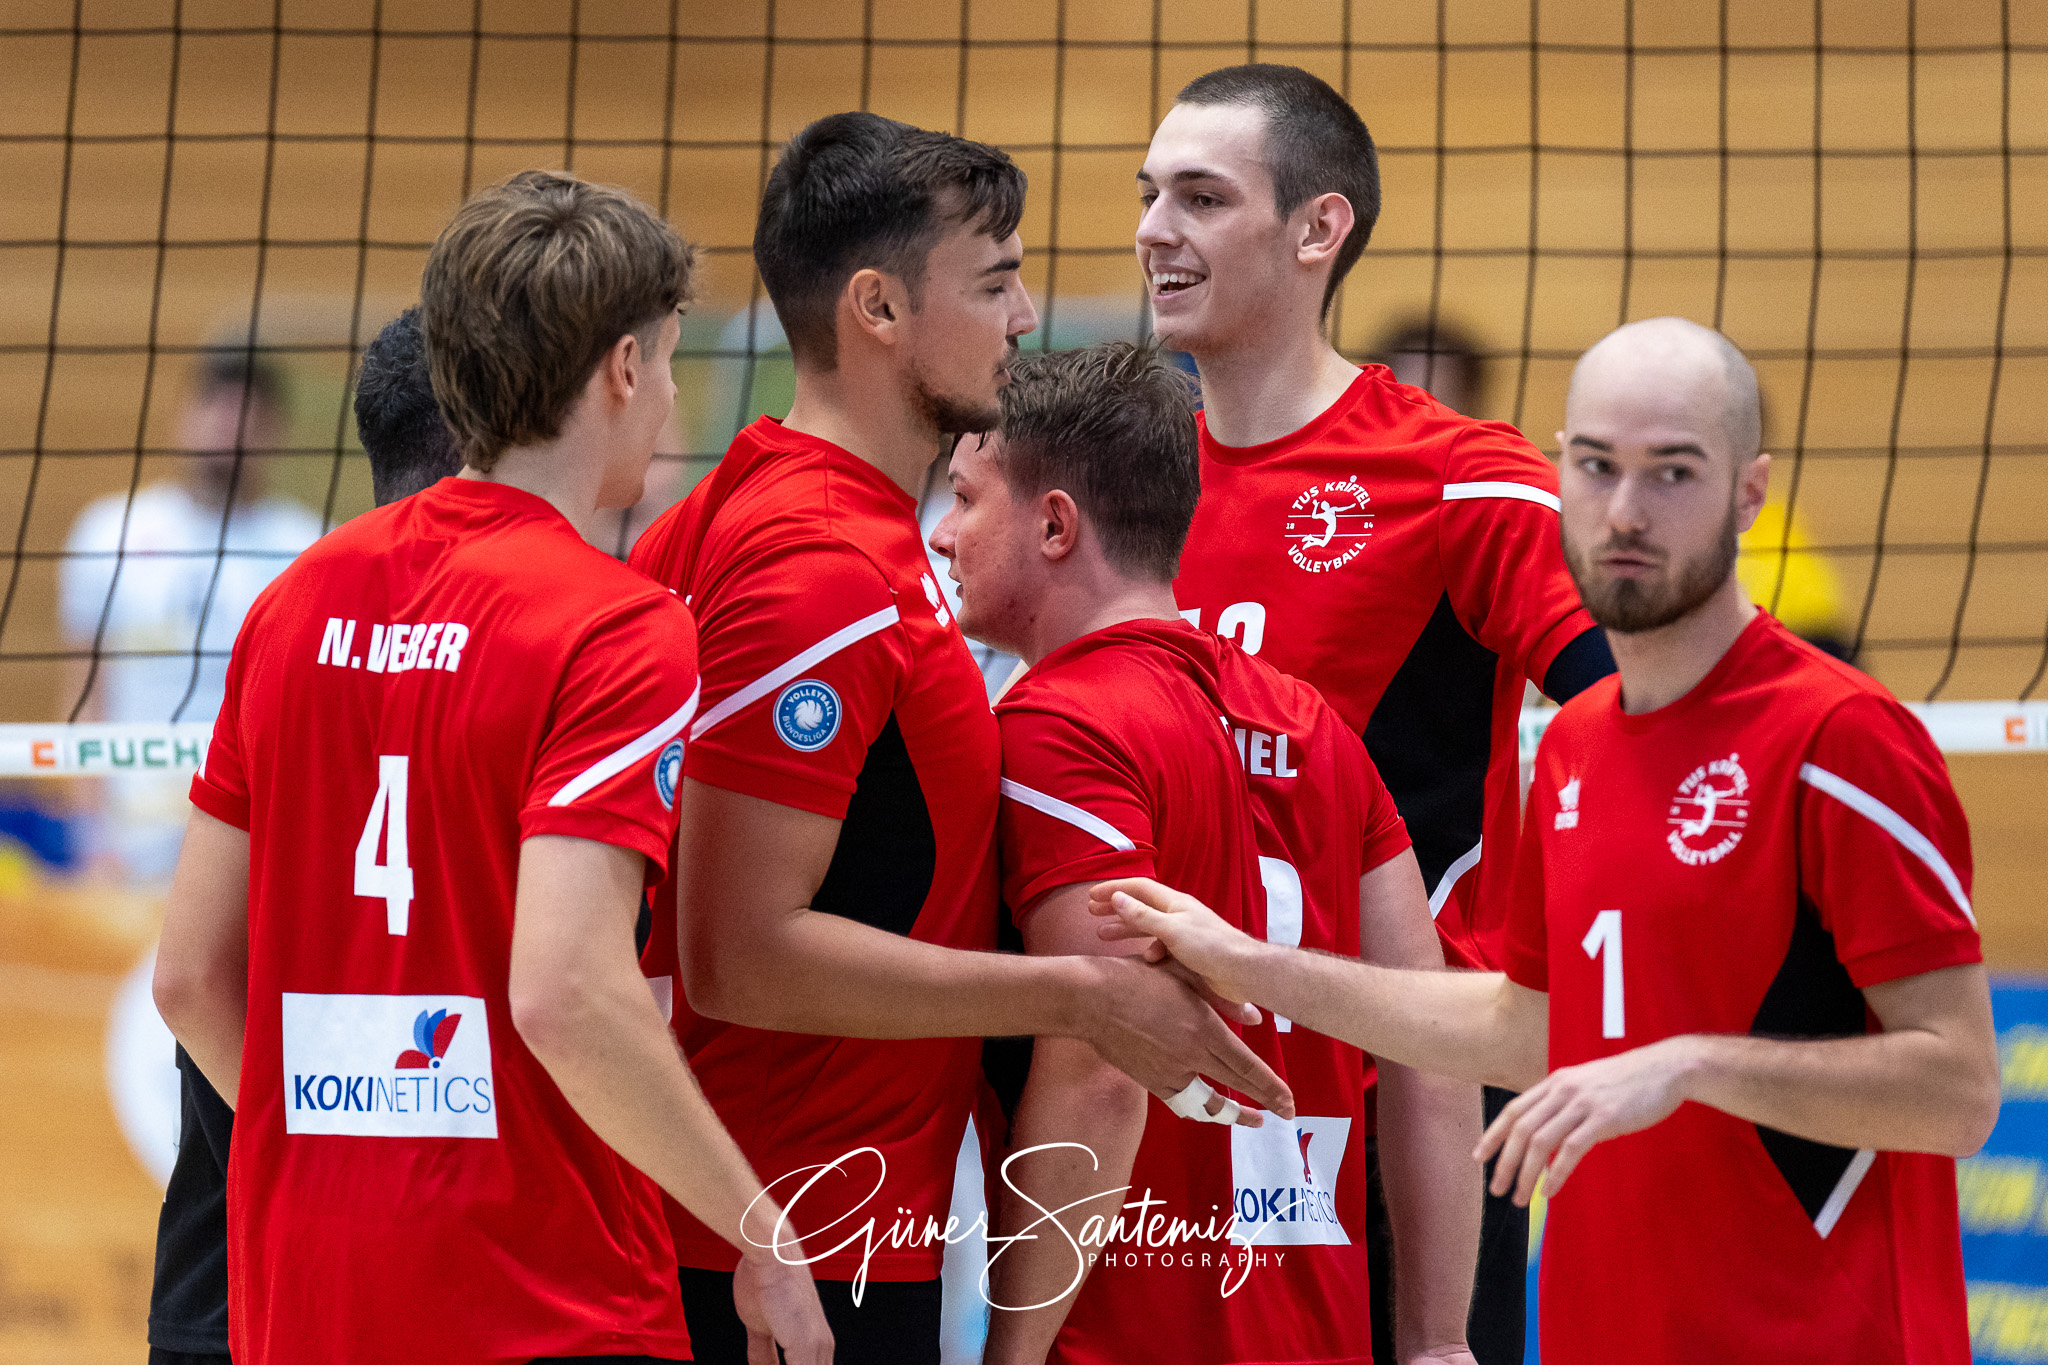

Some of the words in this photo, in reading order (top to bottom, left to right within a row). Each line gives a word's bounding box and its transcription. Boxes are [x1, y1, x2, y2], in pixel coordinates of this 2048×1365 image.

[1292, 485, 1319, 510] TUS
[1324, 481, 1371, 510] KRIFTEL
[1285, 522, 1295, 530] 18
[1287, 541, 1366, 573] VOLLEYBALL
[787, 688, 833, 717] VOLLEYBALL
[782, 715, 826, 742] BUNDESLIGA
[78, 739, 209, 767] FUCH
[354, 755, 414, 936] 4
[1581, 909, 1625, 1039] 1
[294, 1074, 491, 1114] KOKINETICS
